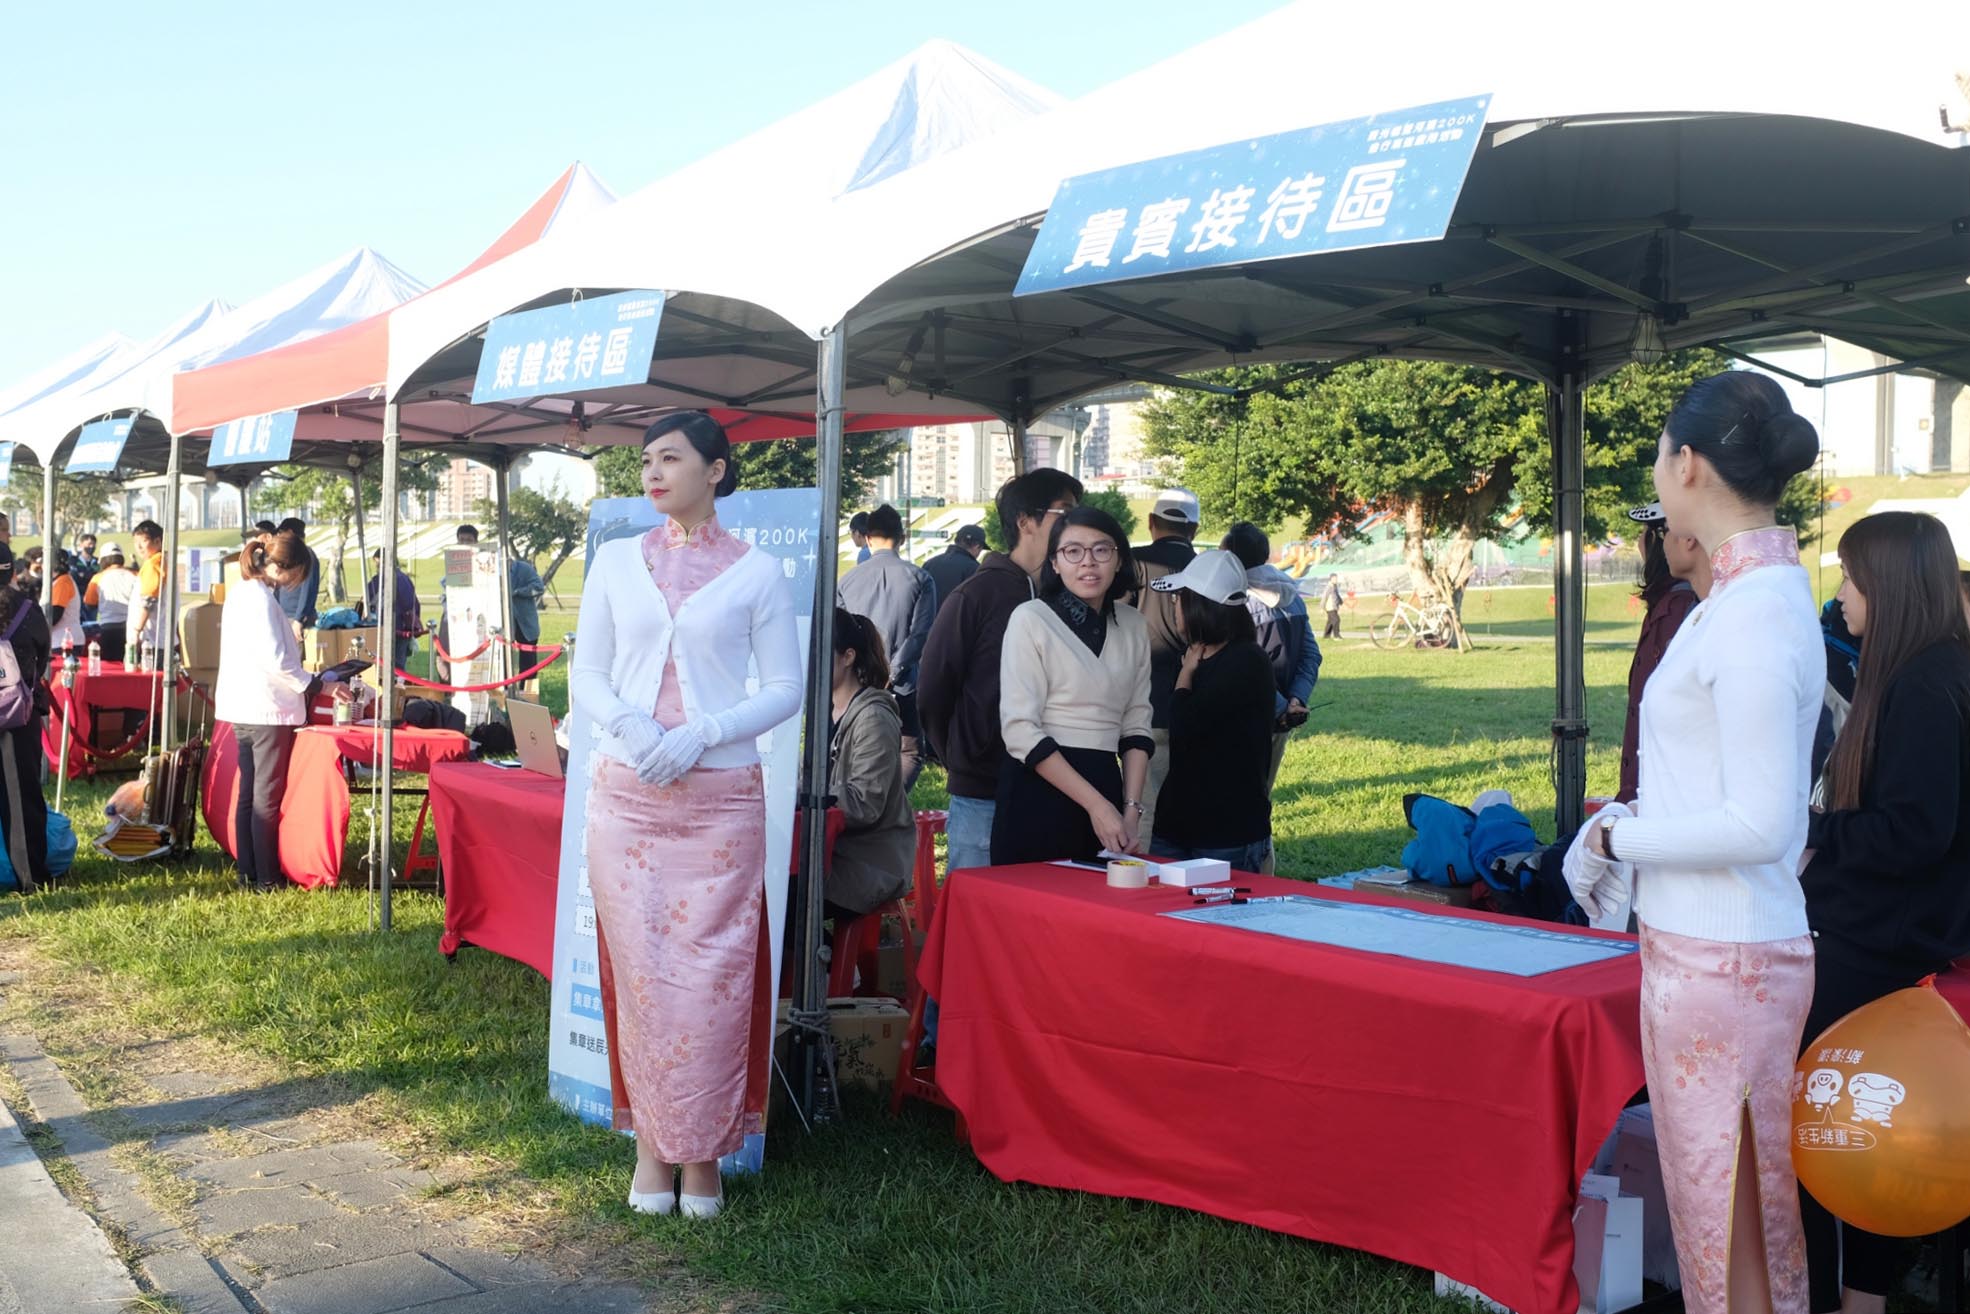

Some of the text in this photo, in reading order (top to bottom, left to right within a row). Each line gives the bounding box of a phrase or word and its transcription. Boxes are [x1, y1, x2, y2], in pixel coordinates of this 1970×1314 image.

[1064, 158, 1407, 275] 貴賓接待區
[492, 326, 633, 391] 媒體接待區
[569, 1031, 609, 1057] 集章送辰
[1798, 1128, 1865, 1146] 三重新生活
